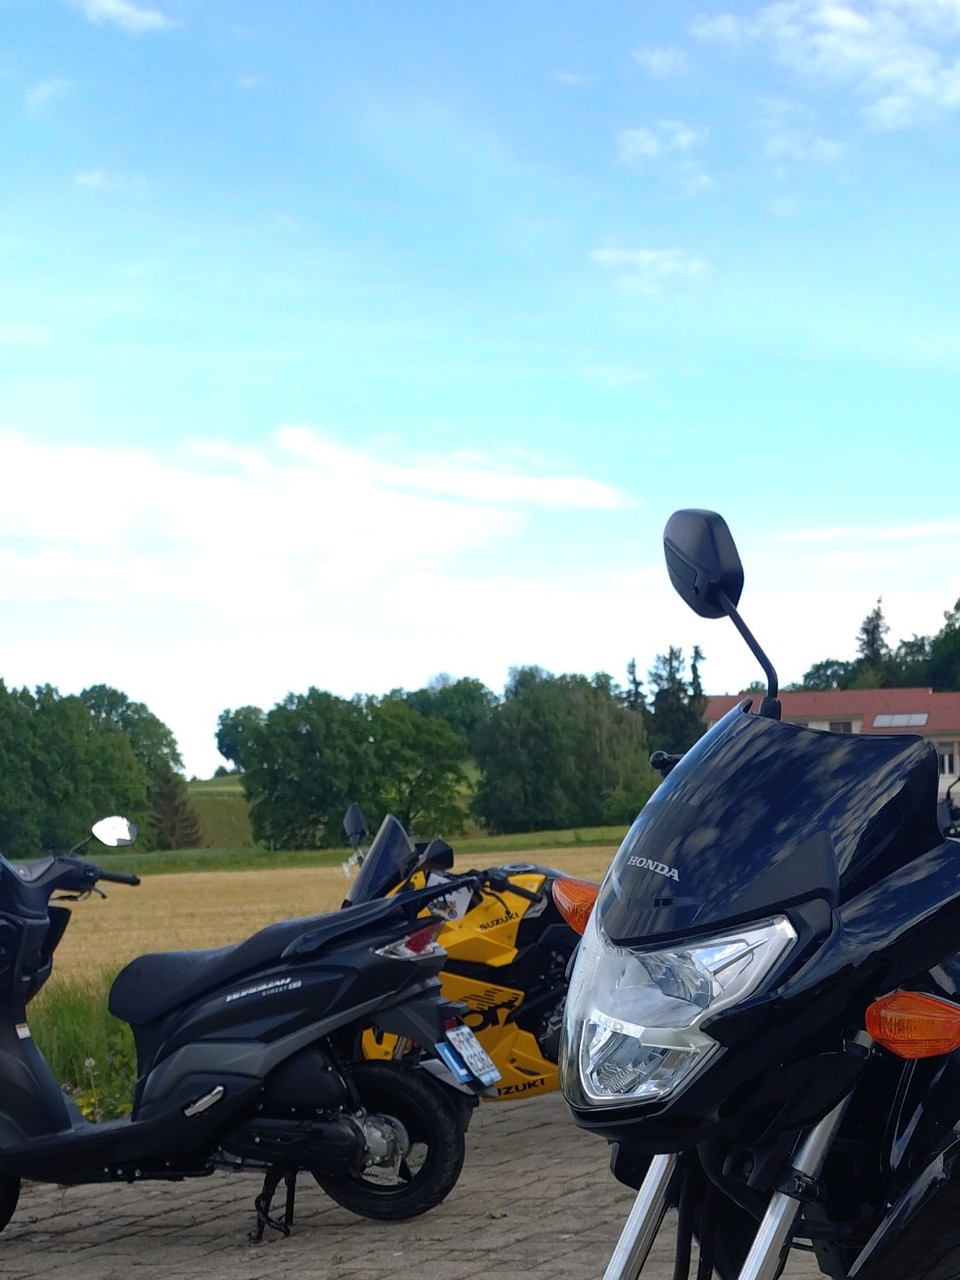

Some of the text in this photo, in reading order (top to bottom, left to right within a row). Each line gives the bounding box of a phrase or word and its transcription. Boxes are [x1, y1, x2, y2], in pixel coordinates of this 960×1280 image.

[627, 856, 680, 882] HONDA
[479, 912, 520, 931] SUZUKI
[444, 1048, 468, 1076] L
[497, 1078, 545, 1097] ZUKI
